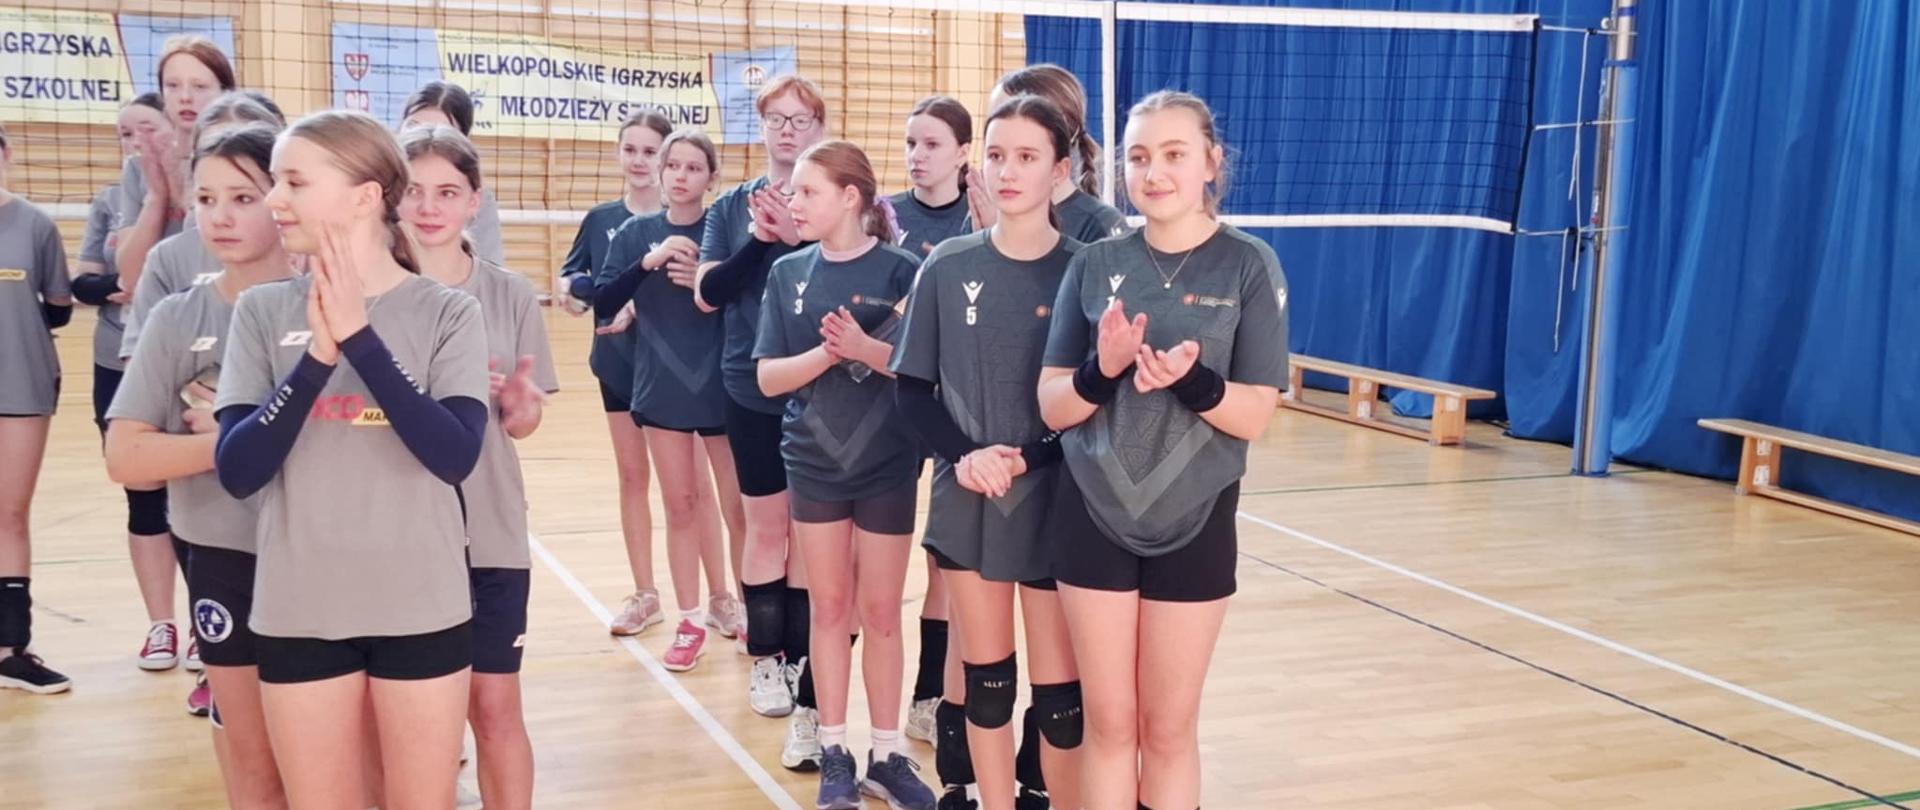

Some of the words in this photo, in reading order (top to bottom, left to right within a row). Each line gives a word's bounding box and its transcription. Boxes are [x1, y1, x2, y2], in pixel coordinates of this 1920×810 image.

[0, 31, 113, 58] GRZYSKA
[447, 52, 606, 84] WIELKOPOLSKIE
[612, 67, 704, 89] IGRZYSKA
[4, 76, 120, 102] SZKOLNEJ
[501, 95, 612, 122] MŁODZIEŻY
[617, 102, 709, 125] SOLNEJ
[794, 298, 804, 315] 3
[966, 306, 977, 326] 5
